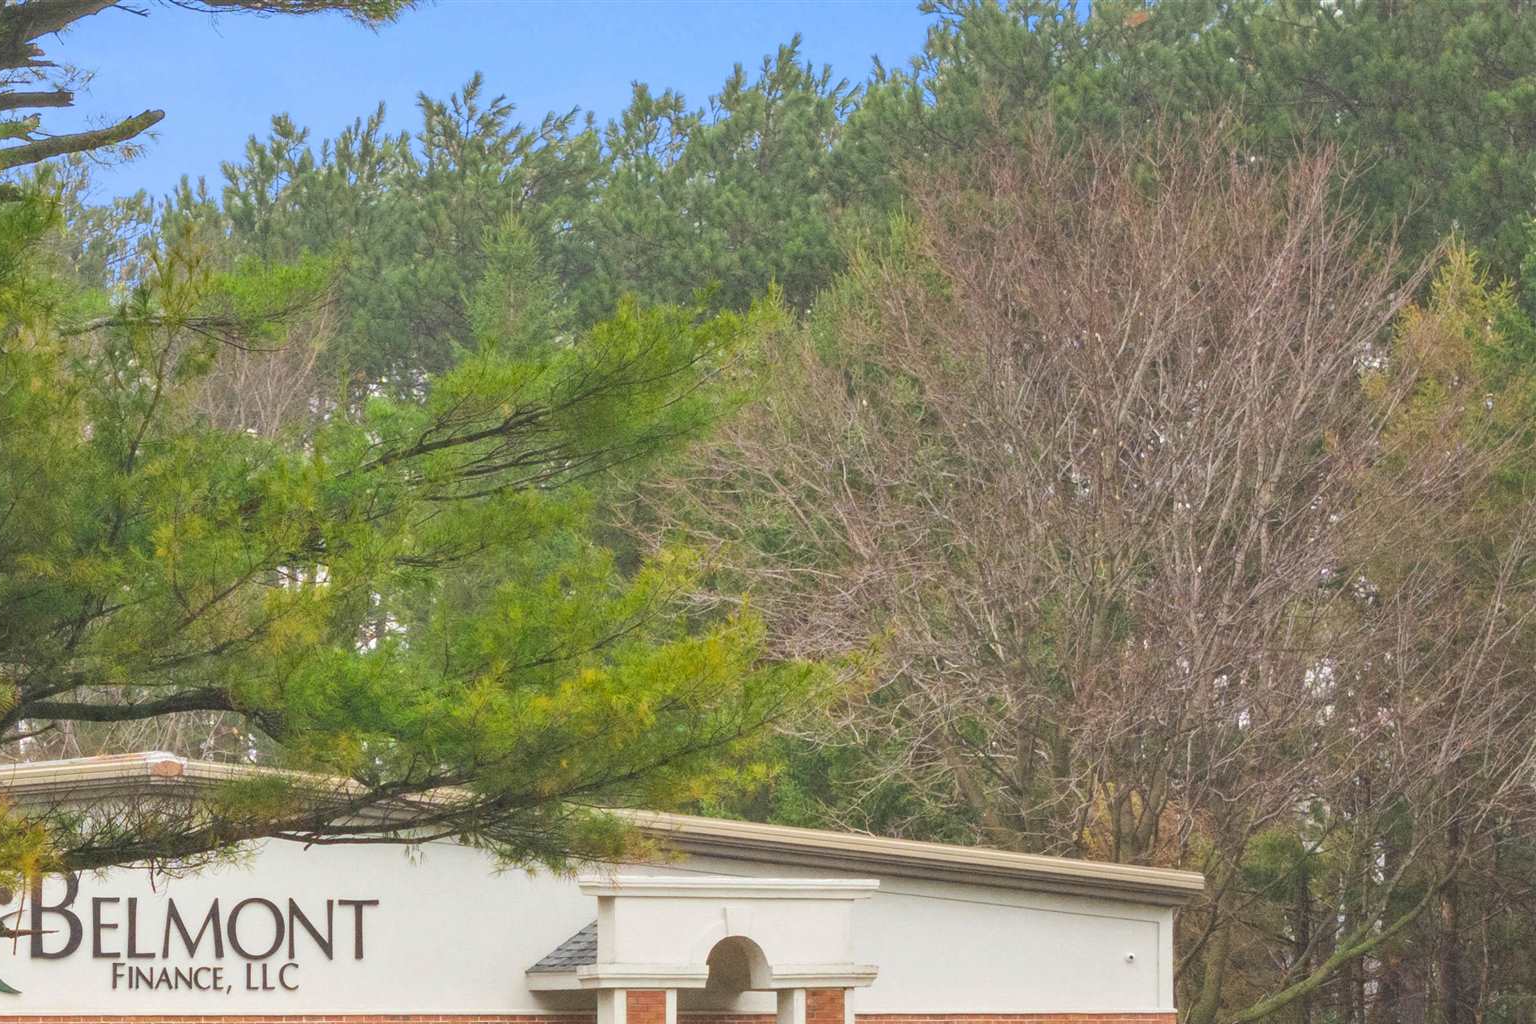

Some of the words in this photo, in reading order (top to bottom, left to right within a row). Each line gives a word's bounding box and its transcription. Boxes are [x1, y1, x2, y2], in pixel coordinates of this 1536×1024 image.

[30, 868, 380, 961] BELMONT
[111, 962, 232, 995] FINANCE,
[246, 962, 300, 991] LLC
